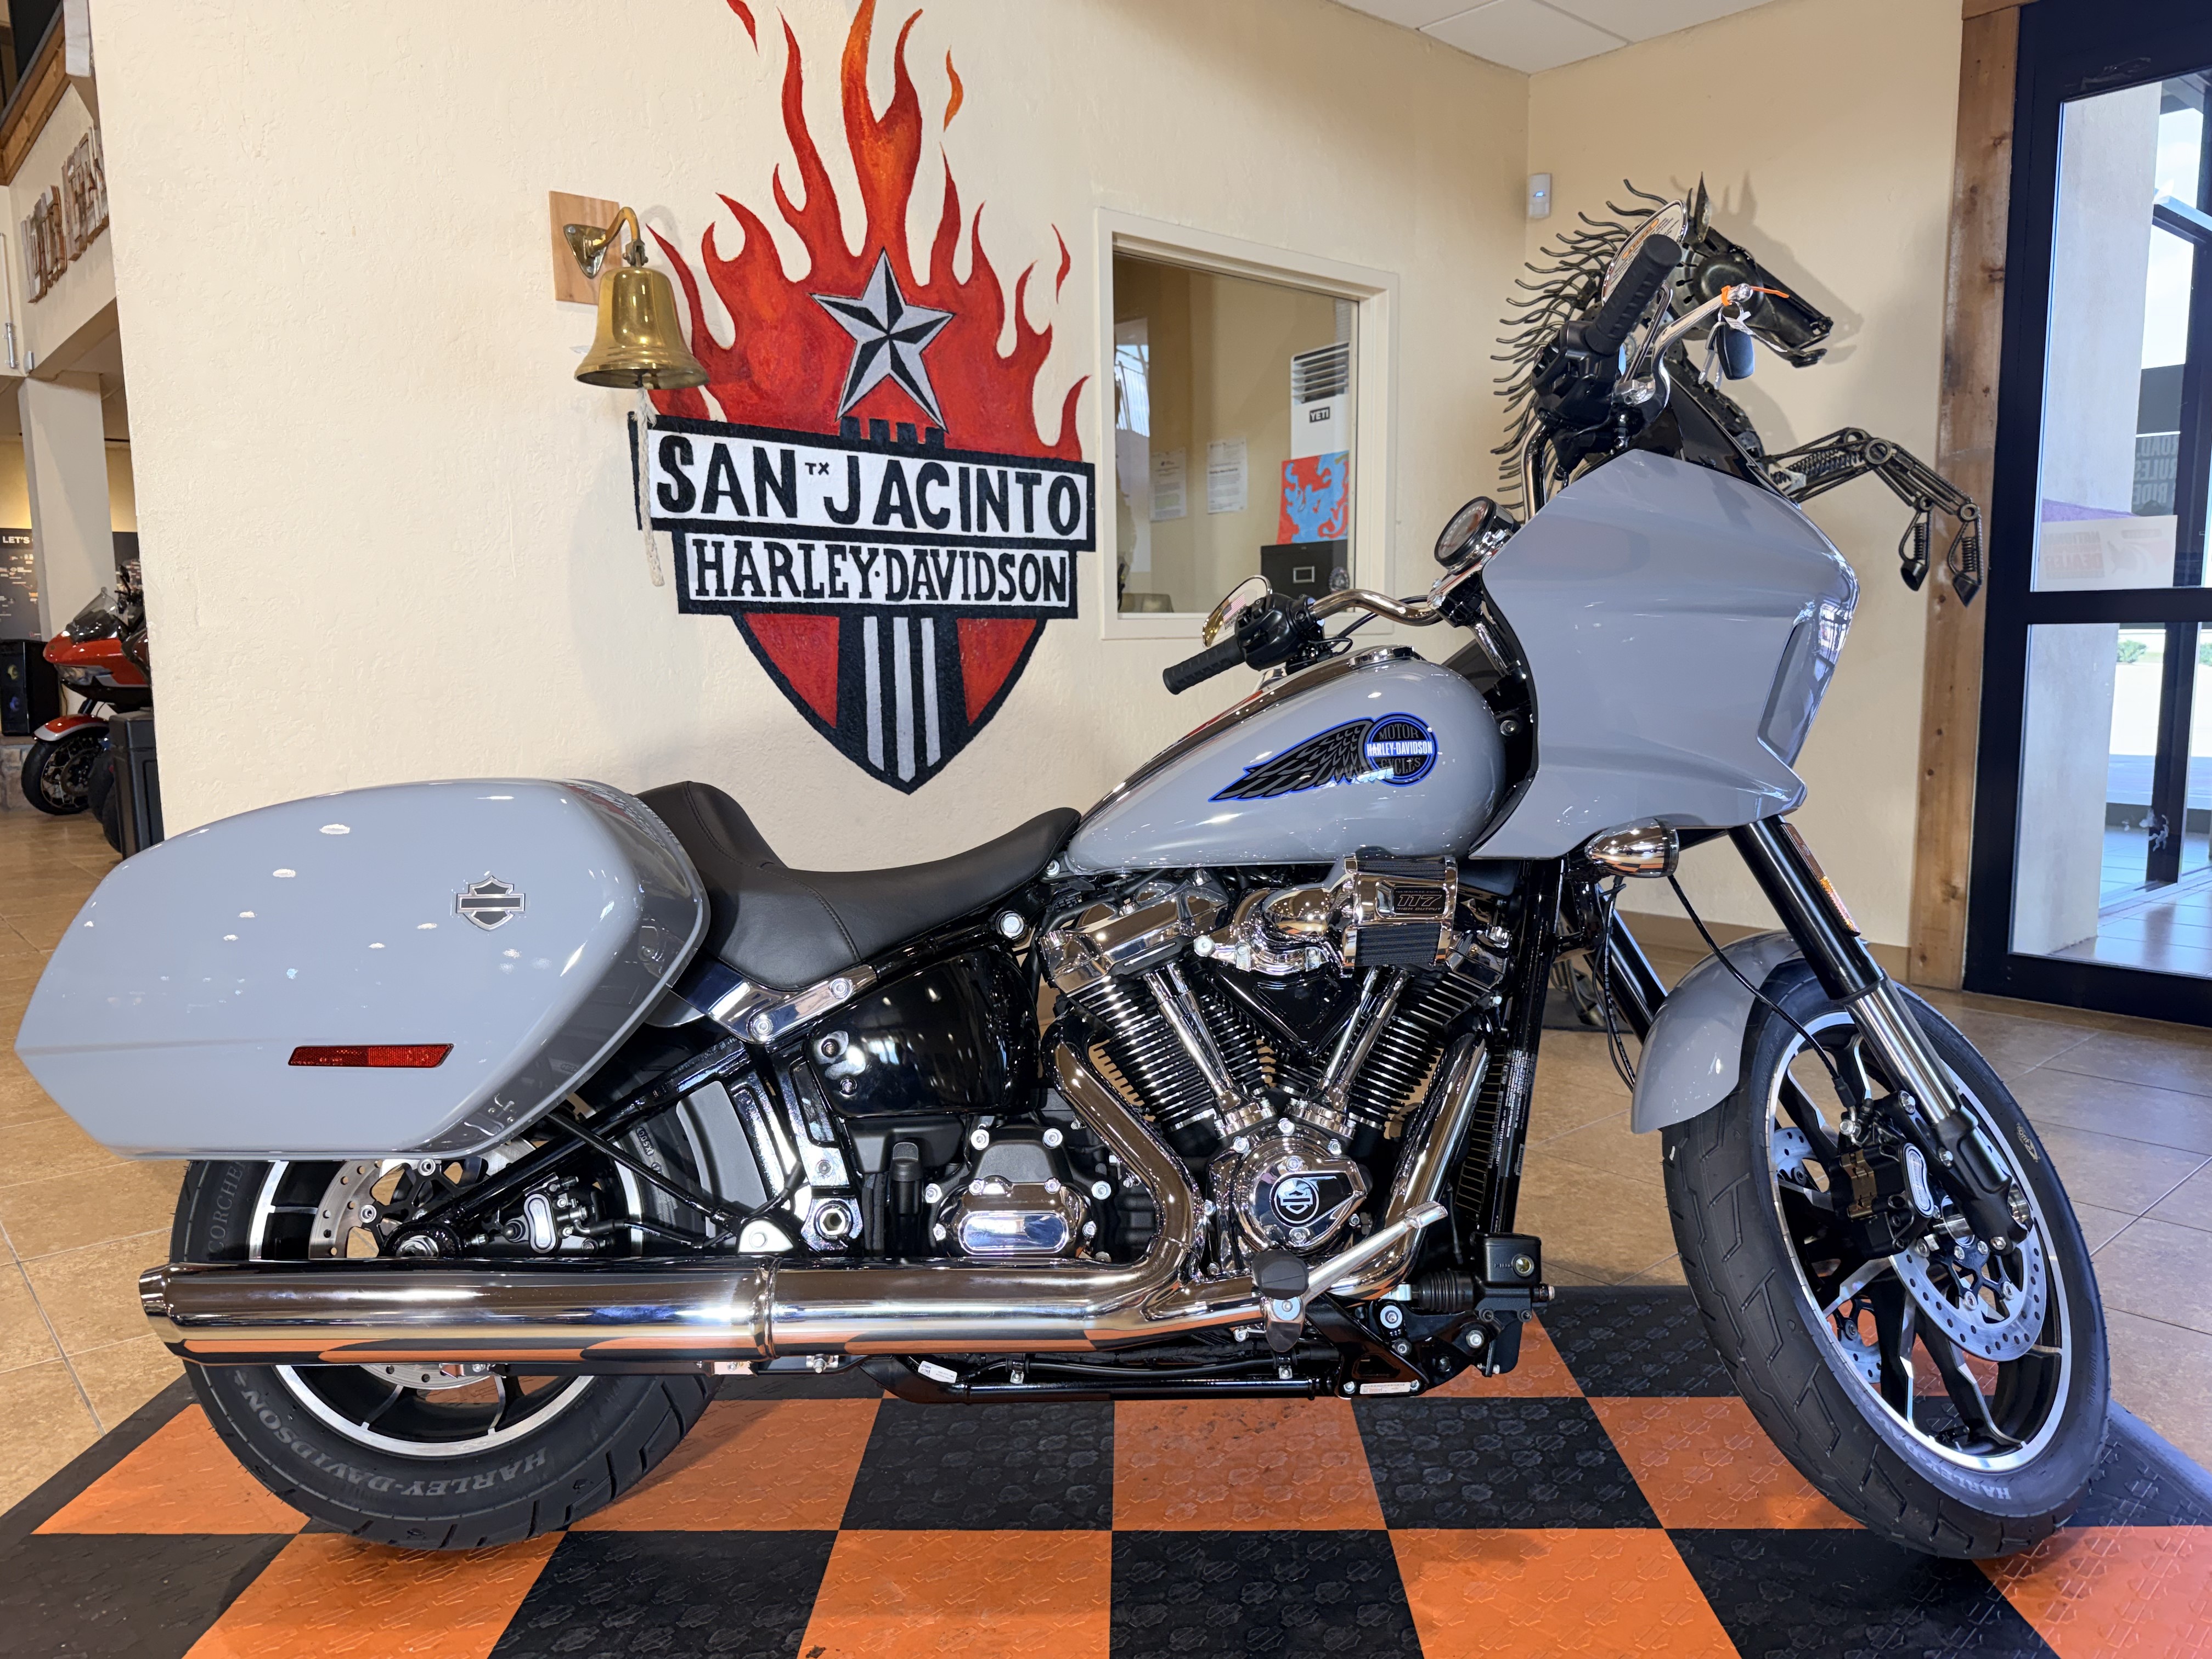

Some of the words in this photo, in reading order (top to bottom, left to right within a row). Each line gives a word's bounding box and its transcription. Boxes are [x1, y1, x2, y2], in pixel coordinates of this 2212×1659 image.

[1311, 409, 1329, 421] YETI
[656, 435, 798, 518] SAN
[805, 461, 830, 477] TX
[823, 455, 1081, 536] JACINTO
[2, 535, 30, 544] LET'S
[1379, 723, 1419, 741] MOTOR
[1367, 741, 1433, 757] HARLEY-DAVIDSON
[1380, 758, 1421, 775] CYCLES
[1397, 894, 1442, 906] 117
[208, 1161, 247, 1253] CORCHE
[239, 1390, 546, 1496] HARLEY-DAVIDSON
